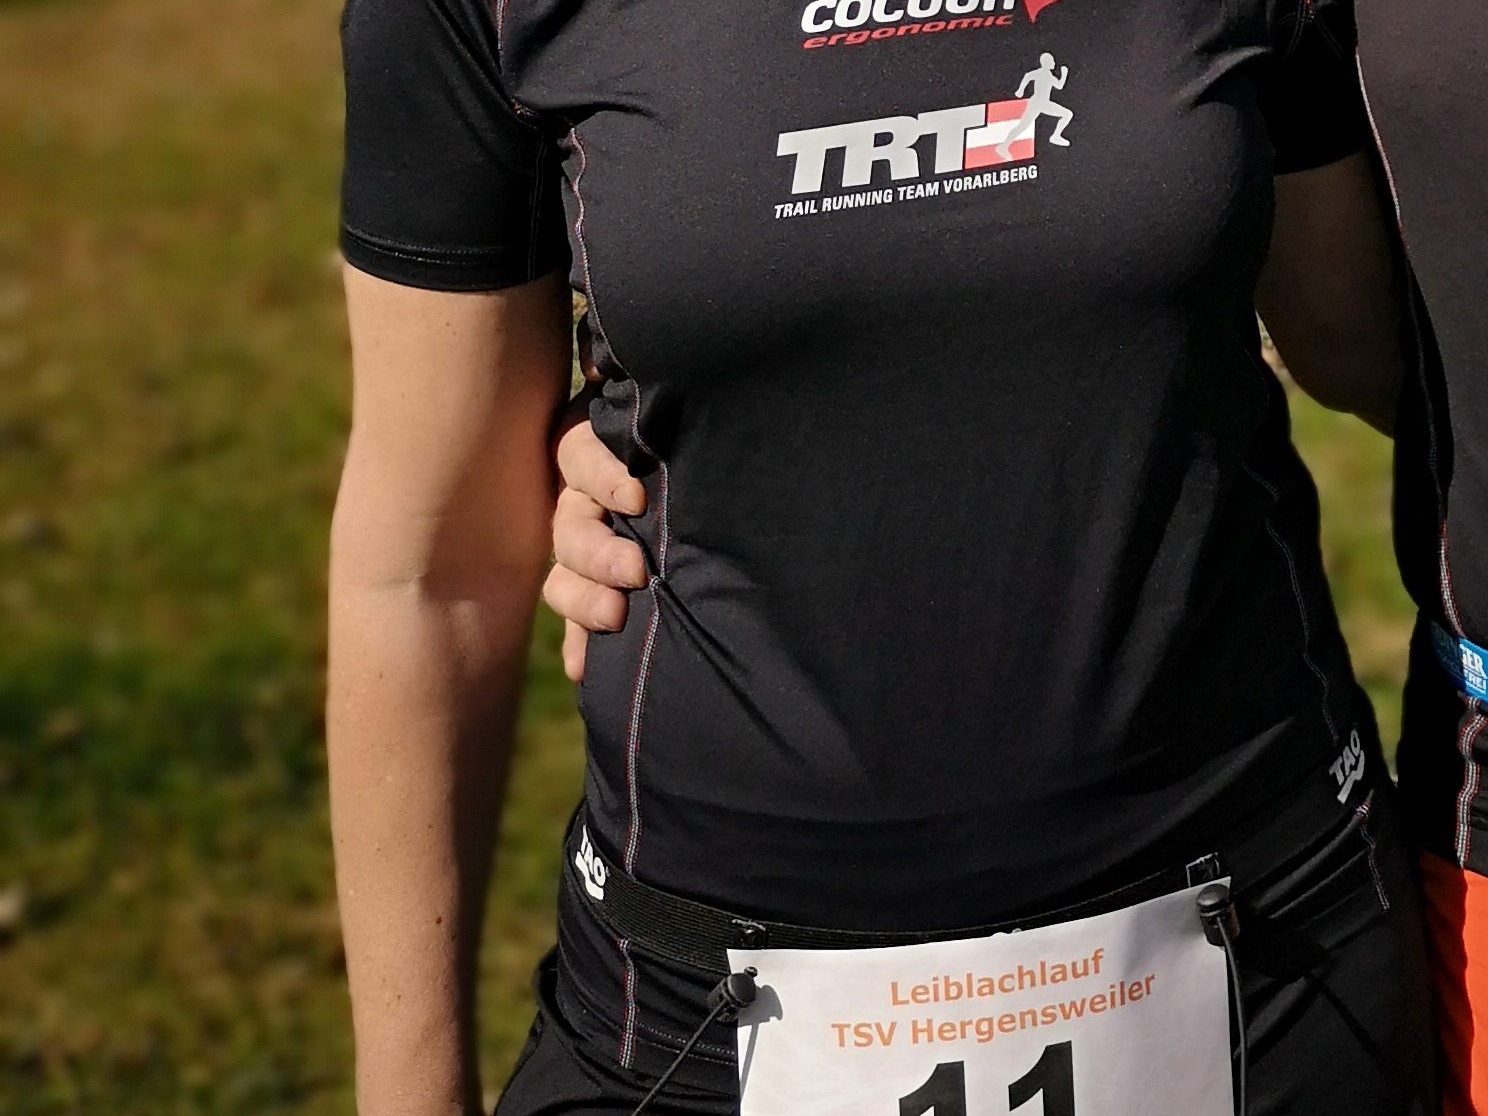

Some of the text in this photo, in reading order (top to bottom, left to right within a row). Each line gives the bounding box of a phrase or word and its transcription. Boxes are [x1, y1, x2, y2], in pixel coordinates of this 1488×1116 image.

[803, 14, 1015, 49] ergonomic
[776, 103, 986, 195] TRT
[774, 165, 1038, 219] TRAIL RUNNING TEAM VORARLBERG
[890, 949, 1104, 1007] Leiblachlauf
[831, 974, 1157, 1049] TSV Hergensweiler
